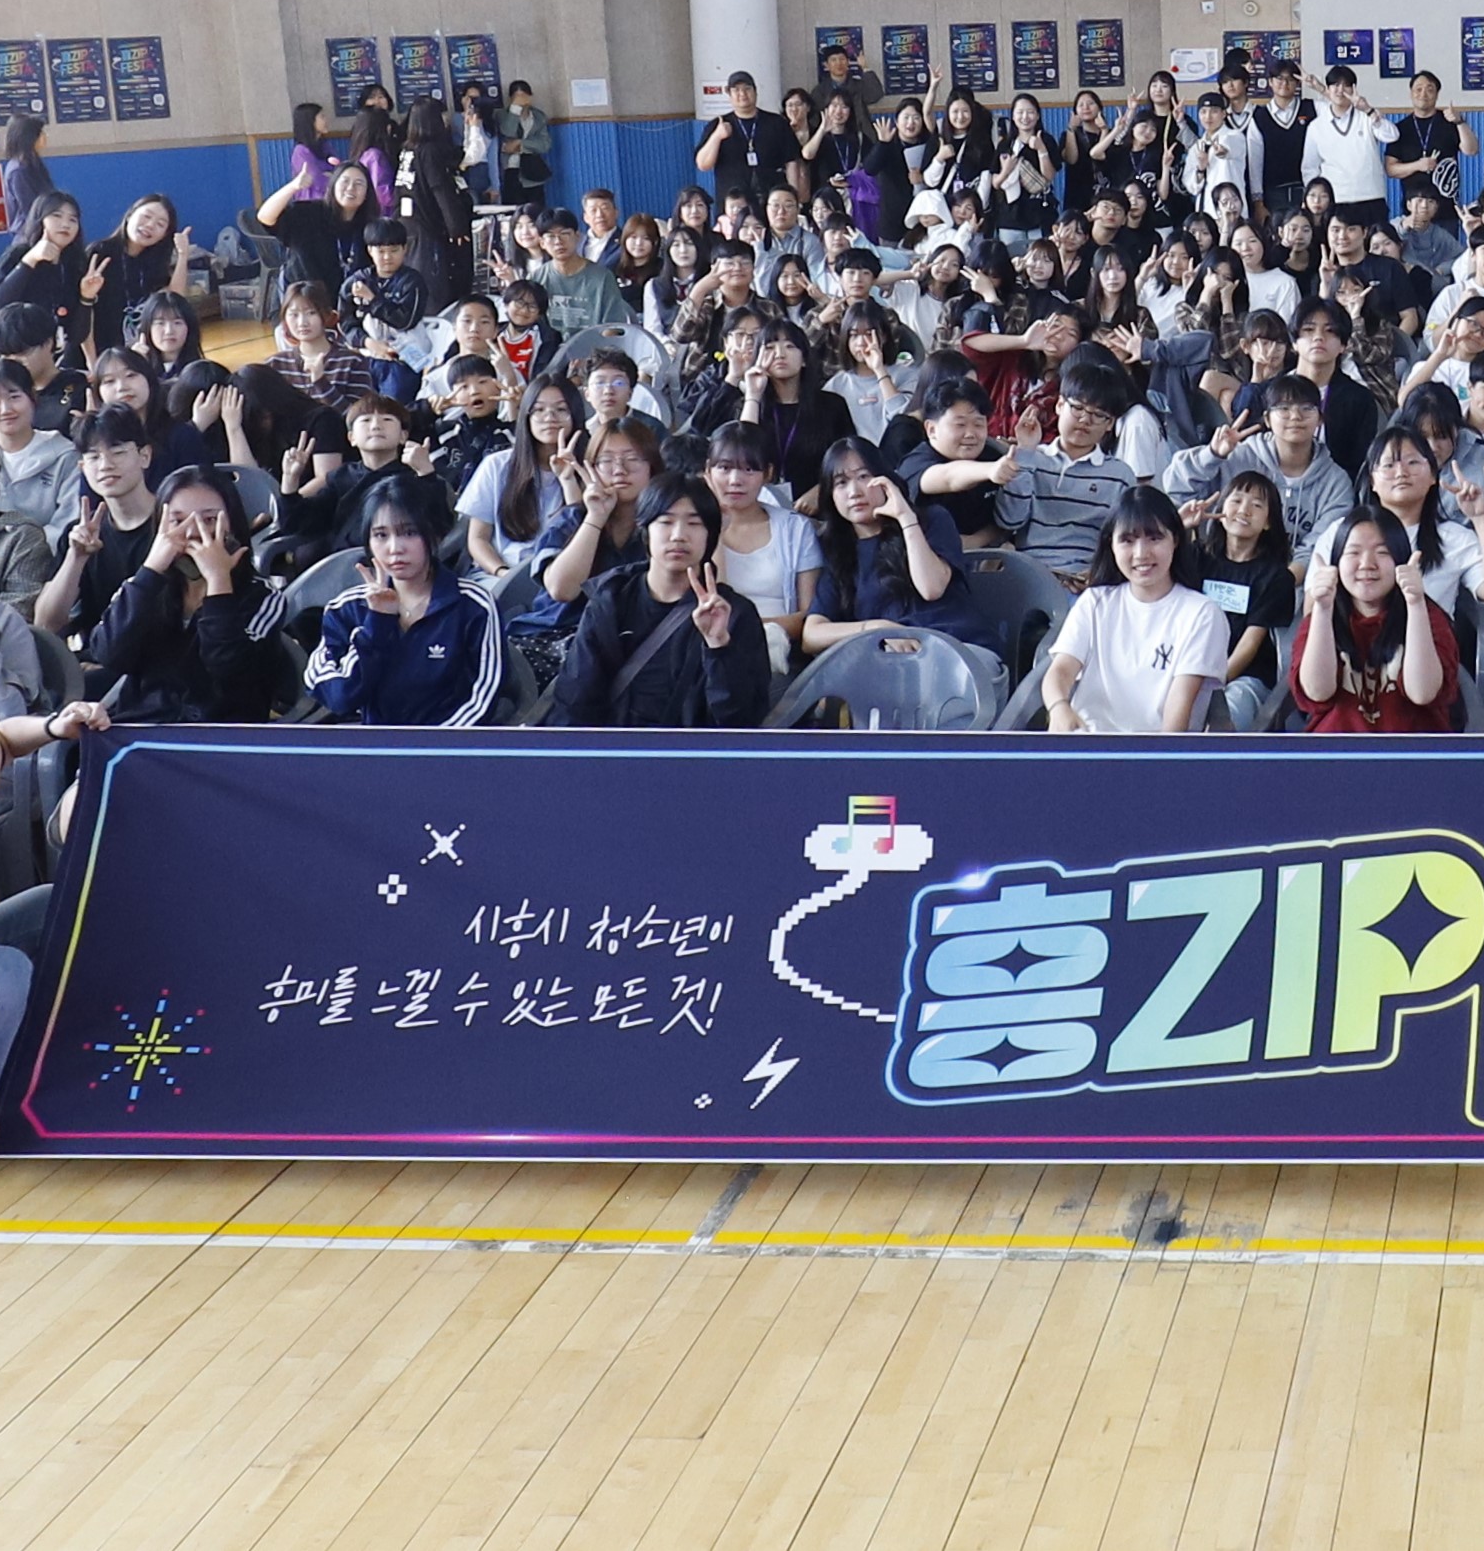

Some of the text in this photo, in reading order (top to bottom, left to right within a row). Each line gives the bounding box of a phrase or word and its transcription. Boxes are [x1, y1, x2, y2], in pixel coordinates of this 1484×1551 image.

[463, 898, 734, 959] 시흥시 청소년이
[258, 964, 723, 1036] 흥미를 느낄 수 있는 모든 것!
